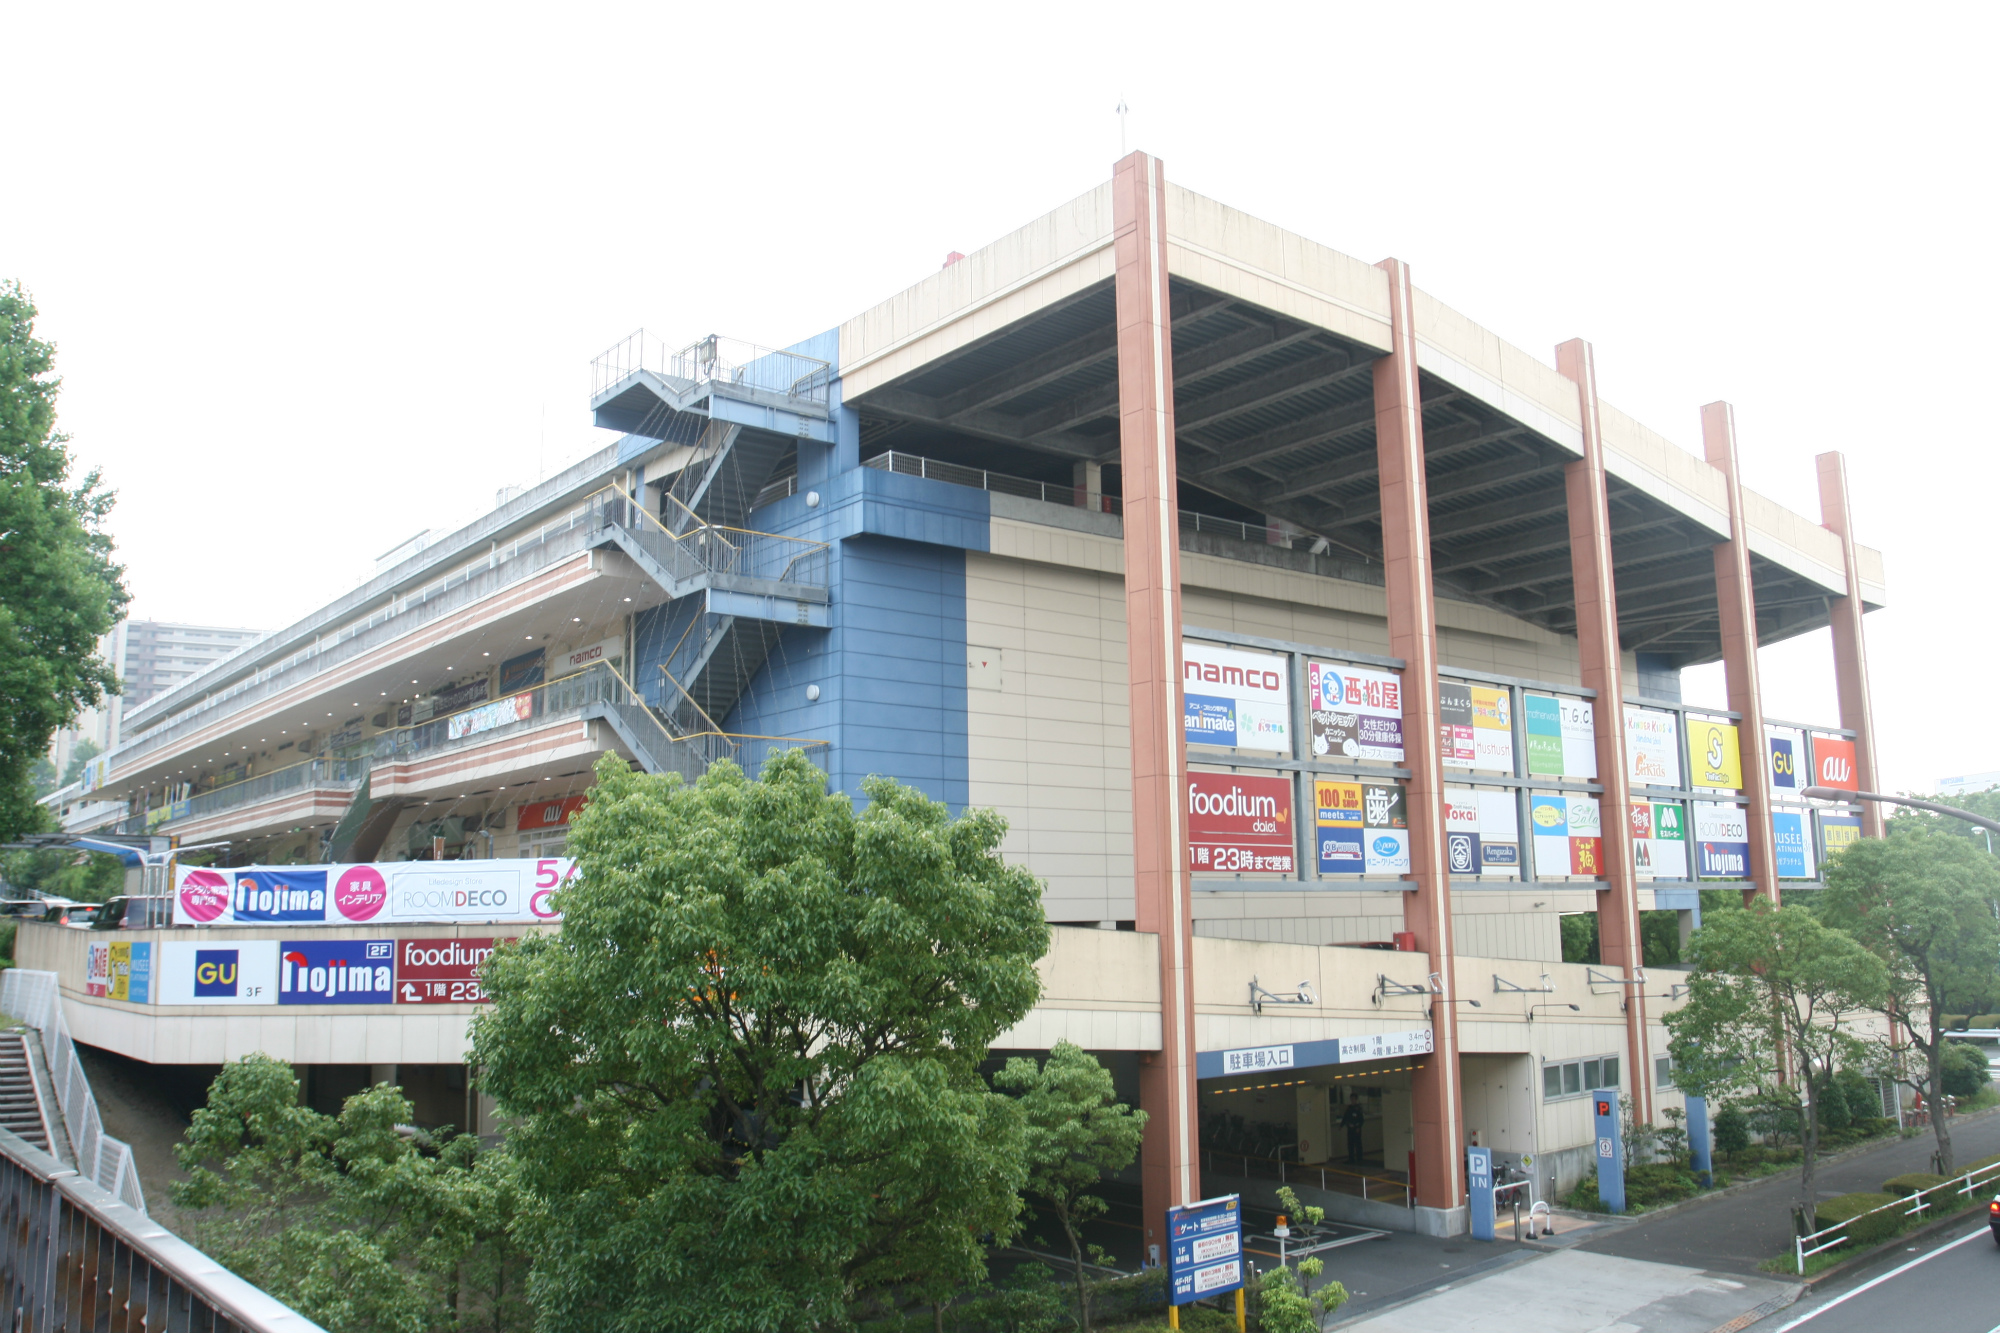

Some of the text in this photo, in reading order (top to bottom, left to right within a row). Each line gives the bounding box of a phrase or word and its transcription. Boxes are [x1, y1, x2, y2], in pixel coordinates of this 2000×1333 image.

[569, 646, 602, 666] namco
[1184, 660, 1280, 691] namco
[1344, 676, 1399, 710] 西松屋
[1184, 710, 1236, 732] animate
[1773, 751, 1793, 775] GU
[1823, 756, 1851, 782] au
[1188, 783, 1276, 818] foodium
[1318, 788, 1356, 807] 100 YEN
[1342, 799, 1359, 809] SHOP
[1365, 787, 1389, 825] 歯
[543, 806, 563, 823] au
[1189, 846, 1292, 870] 1階 23時まで営業
[349, 880, 372, 893] 家具
[464, 877, 483, 885] Store
[235, 878, 324, 915] nojima
[338, 893, 383, 906] インテリア
[403, 889, 508, 909] ROOMDECO
[370, 945, 388, 956] 2F
[196, 961, 237, 985] GU
[281, 950, 392, 998] nojima
[245, 986, 263, 997] 3F
[425, 982, 447, 997] 1階
[1372, 1032, 1424, 1046] 1階 3.4m
[1409, 1043, 1425, 1052] 2.2m
[1341, 1043, 1367, 1056] 高さ制限
[1229, 1049, 1290, 1071] 駐車場入口
[1598, 1101, 1610, 1117] P
[1473, 1156, 1484, 1172] P
[1472, 1176, 1488, 1189] IN
[1178, 1246, 1186, 1256] 1F
